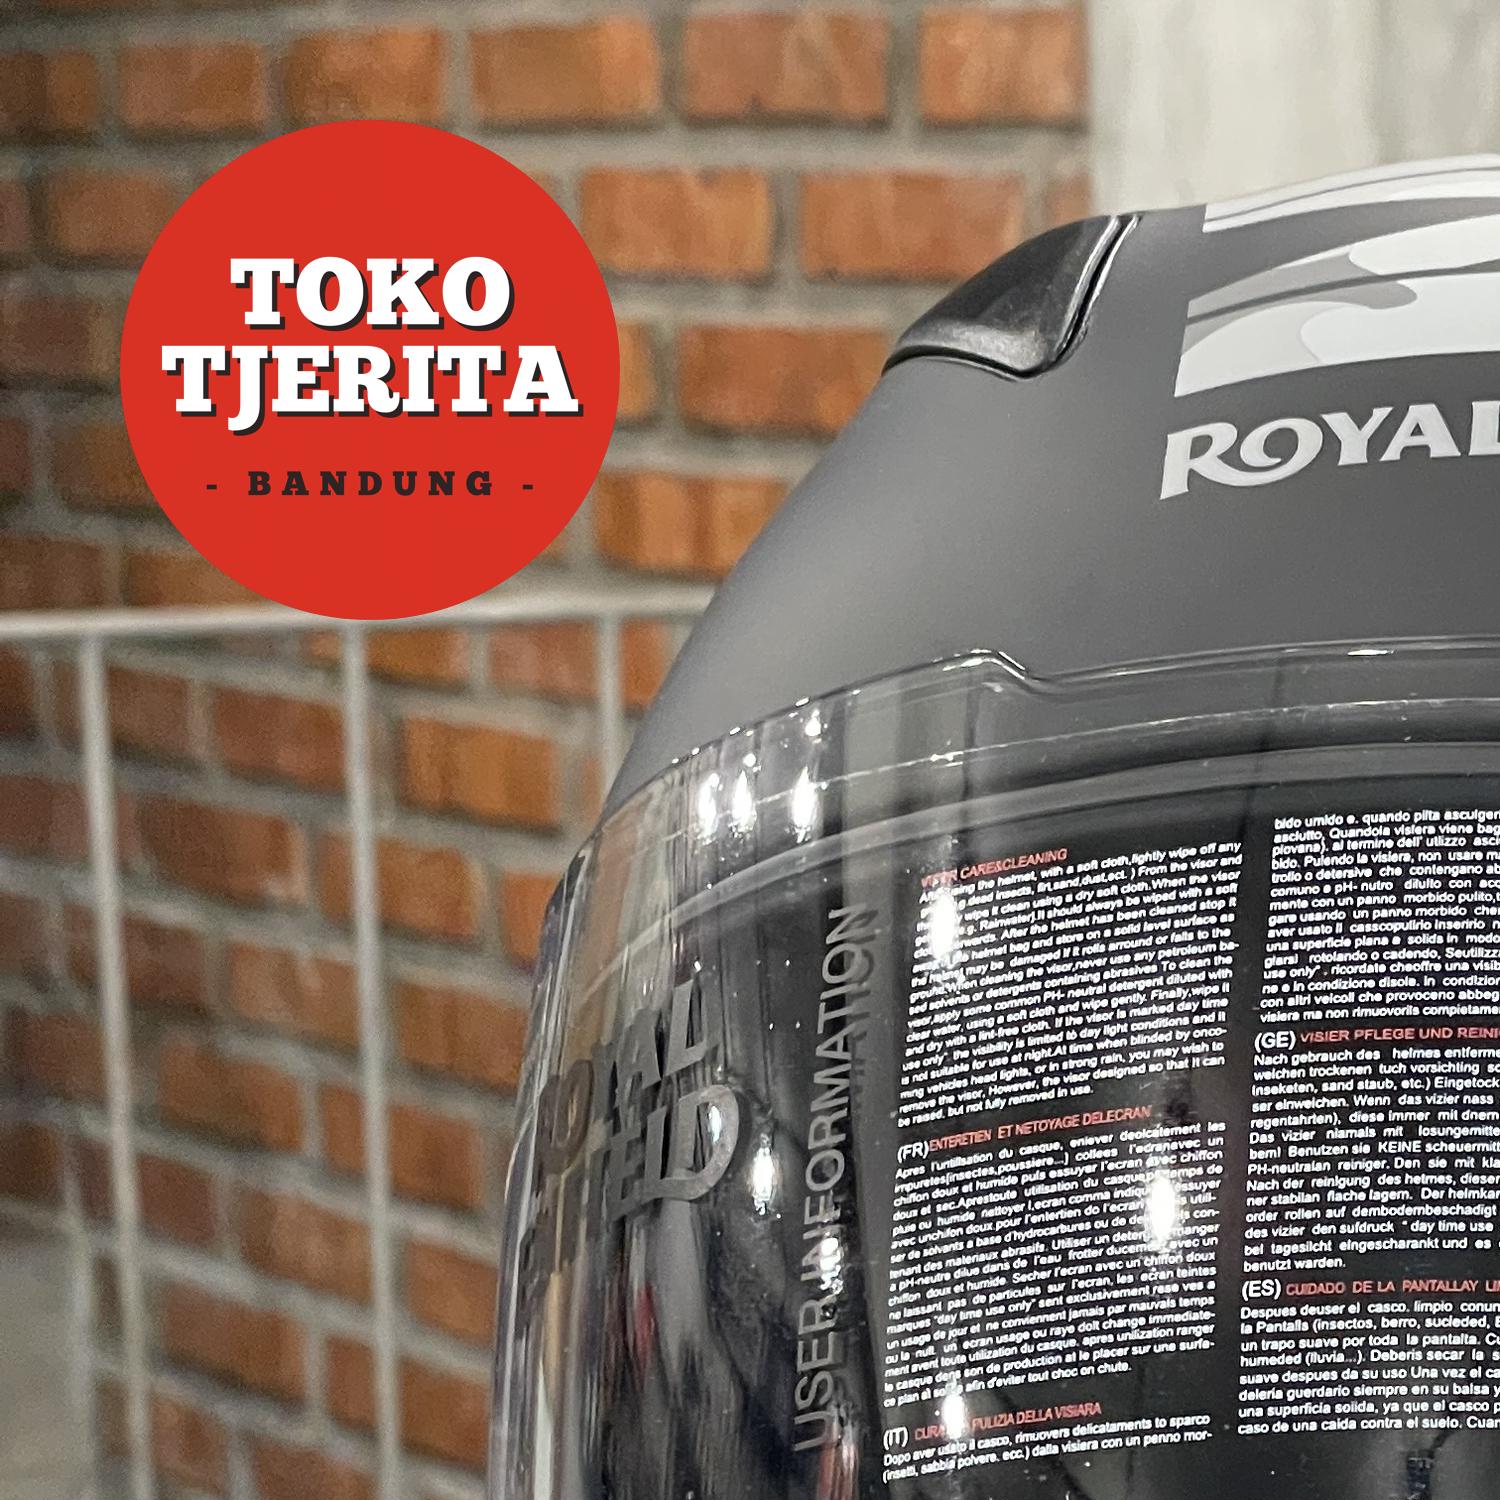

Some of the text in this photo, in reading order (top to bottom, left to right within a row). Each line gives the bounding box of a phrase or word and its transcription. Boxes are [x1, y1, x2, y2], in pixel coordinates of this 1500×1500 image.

[1254, 1031, 1296, 1050] (GE)
[1301, 1028, 1350, 1044] VISIER
[1354, 1027, 1416, 1041] PFLEGE
[1419, 1026, 1453, 1040] UND
[897, 1140, 929, 1164] (FR)
[1242, 1278, 1281, 1299] (ES)
[1352, 1280, 1373, 1294] DE
[793, 1297, 842, 1451] USER
